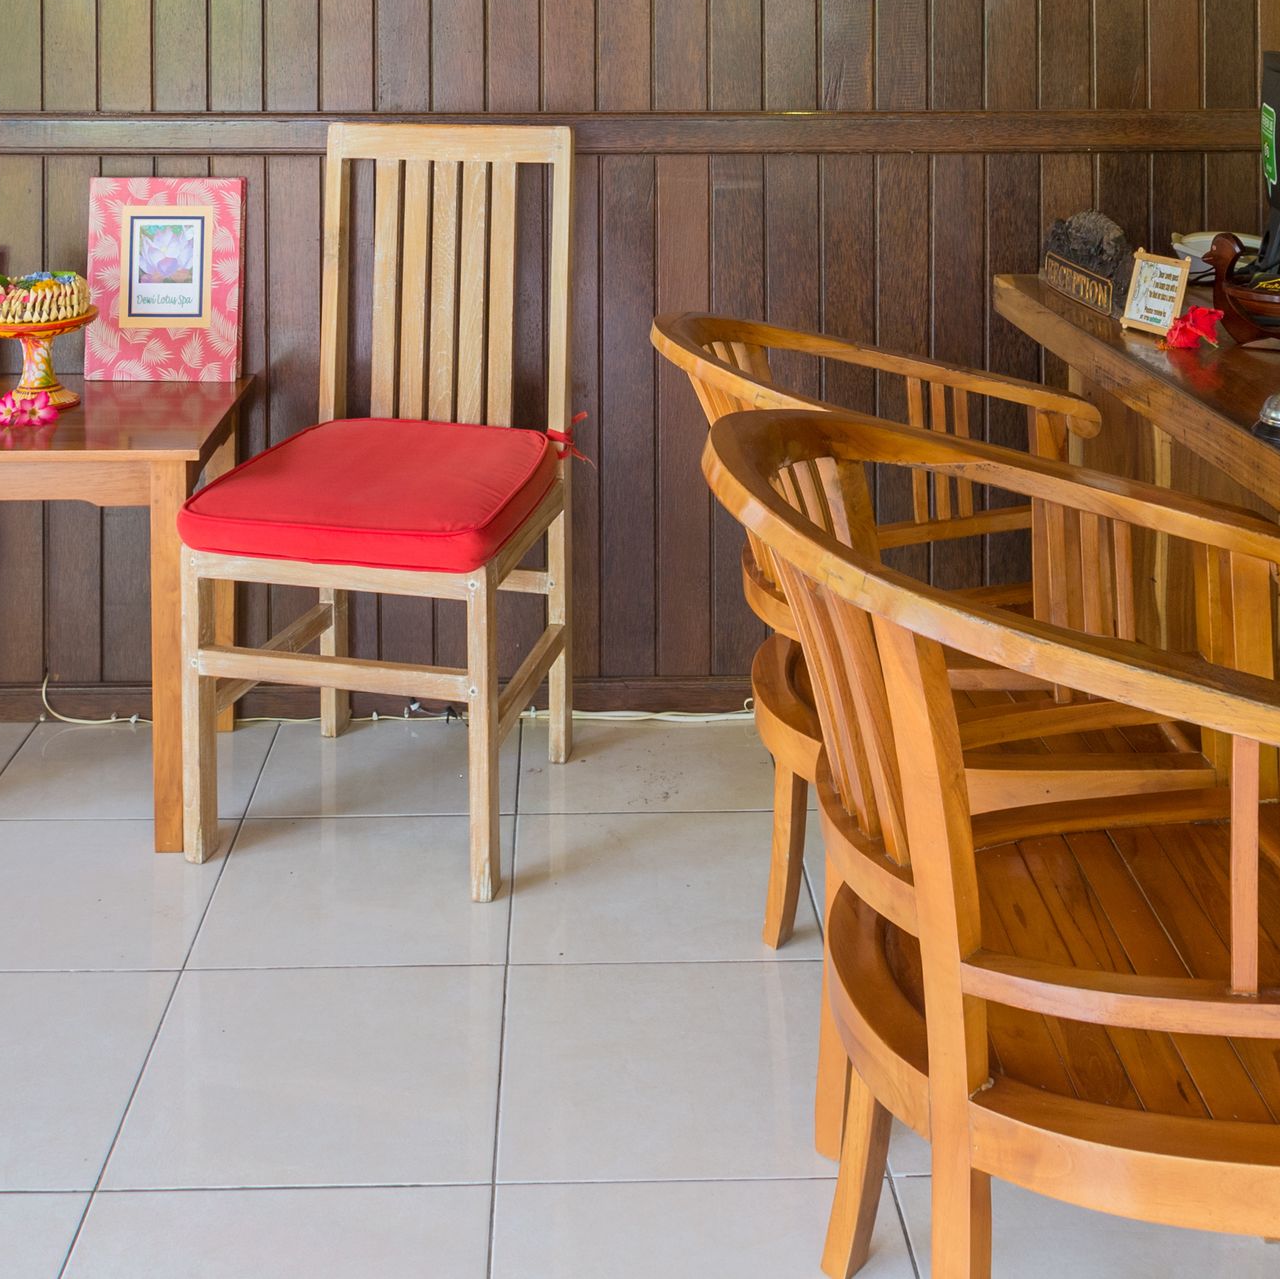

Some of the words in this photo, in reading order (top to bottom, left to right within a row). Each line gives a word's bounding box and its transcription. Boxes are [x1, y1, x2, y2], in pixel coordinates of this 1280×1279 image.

[1047, 258, 1107, 308] RECEPTION
[136, 294, 156, 305] Dewi
[157, 295, 177, 305] Lotus
[178, 295, 193, 308] Spa
